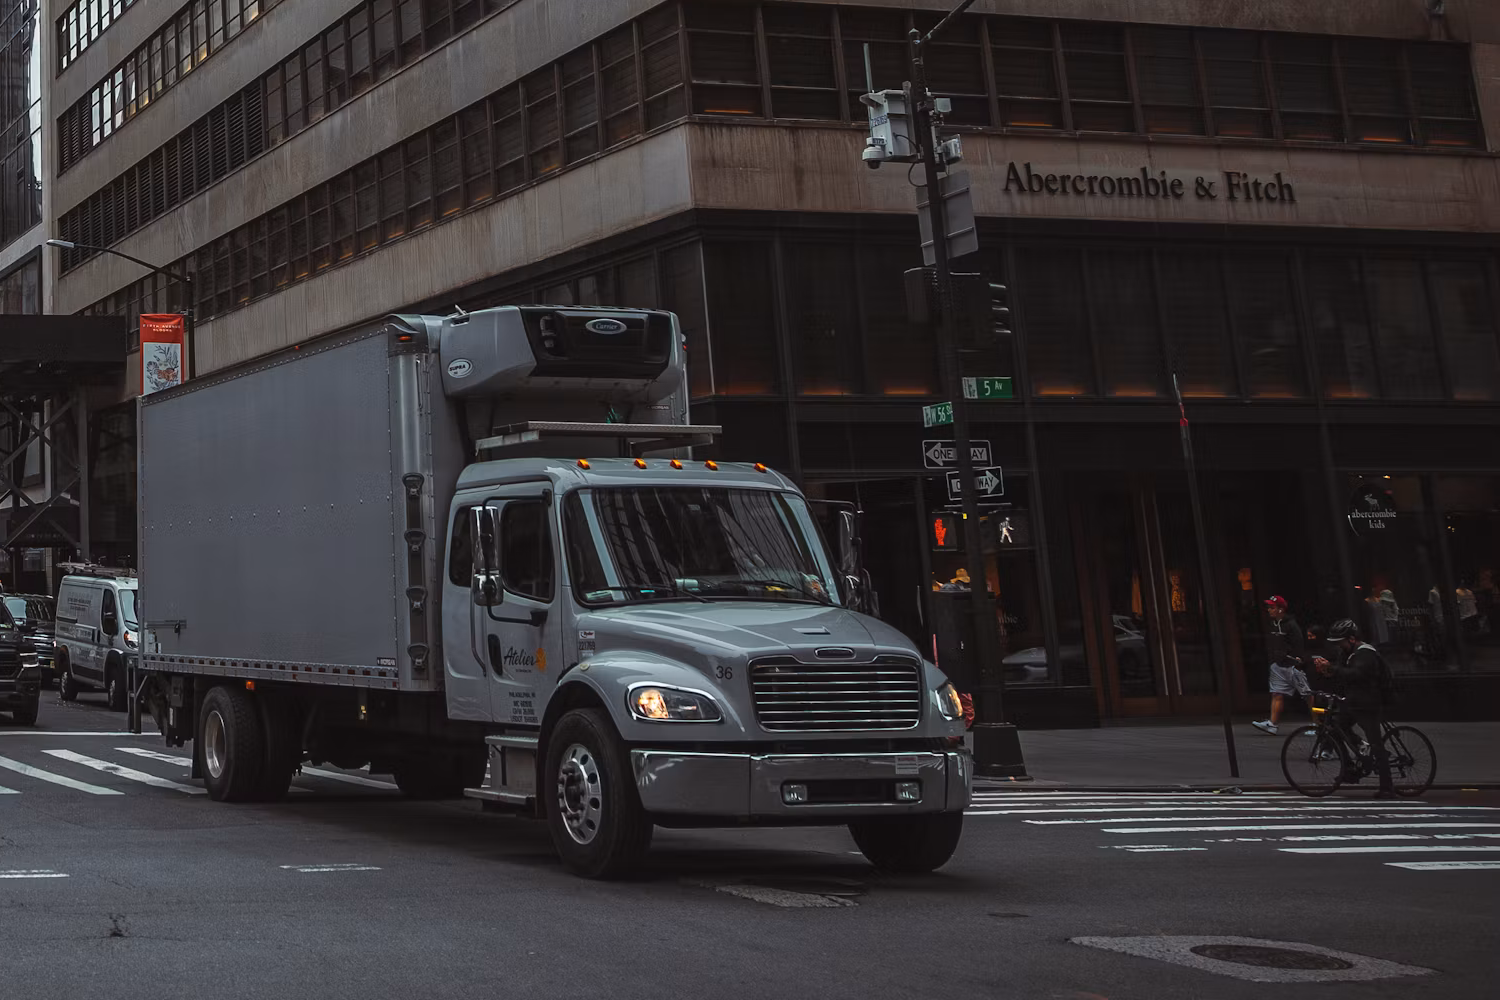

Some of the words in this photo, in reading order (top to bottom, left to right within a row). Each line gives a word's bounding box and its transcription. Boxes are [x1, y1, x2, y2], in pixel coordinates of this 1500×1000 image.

[1004, 160, 1185, 199] Abercrombie
[1194, 176, 1217, 199] &
[1225, 170, 1297, 203] Fitch
[595, 322, 619, 331] Carrier
[983, 380, 991, 396] 5
[994, 380, 1003, 390] Av
[937, 405, 946, 423] 56
[933, 448, 953, 460] ONE
[977, 476, 994, 488] WAY
[1351, 508, 1397, 519] abercrombie
[1369, 519, 1386, 529] kids
[504, 646, 537, 667] Atelier
[715, 665, 733, 680] 36
